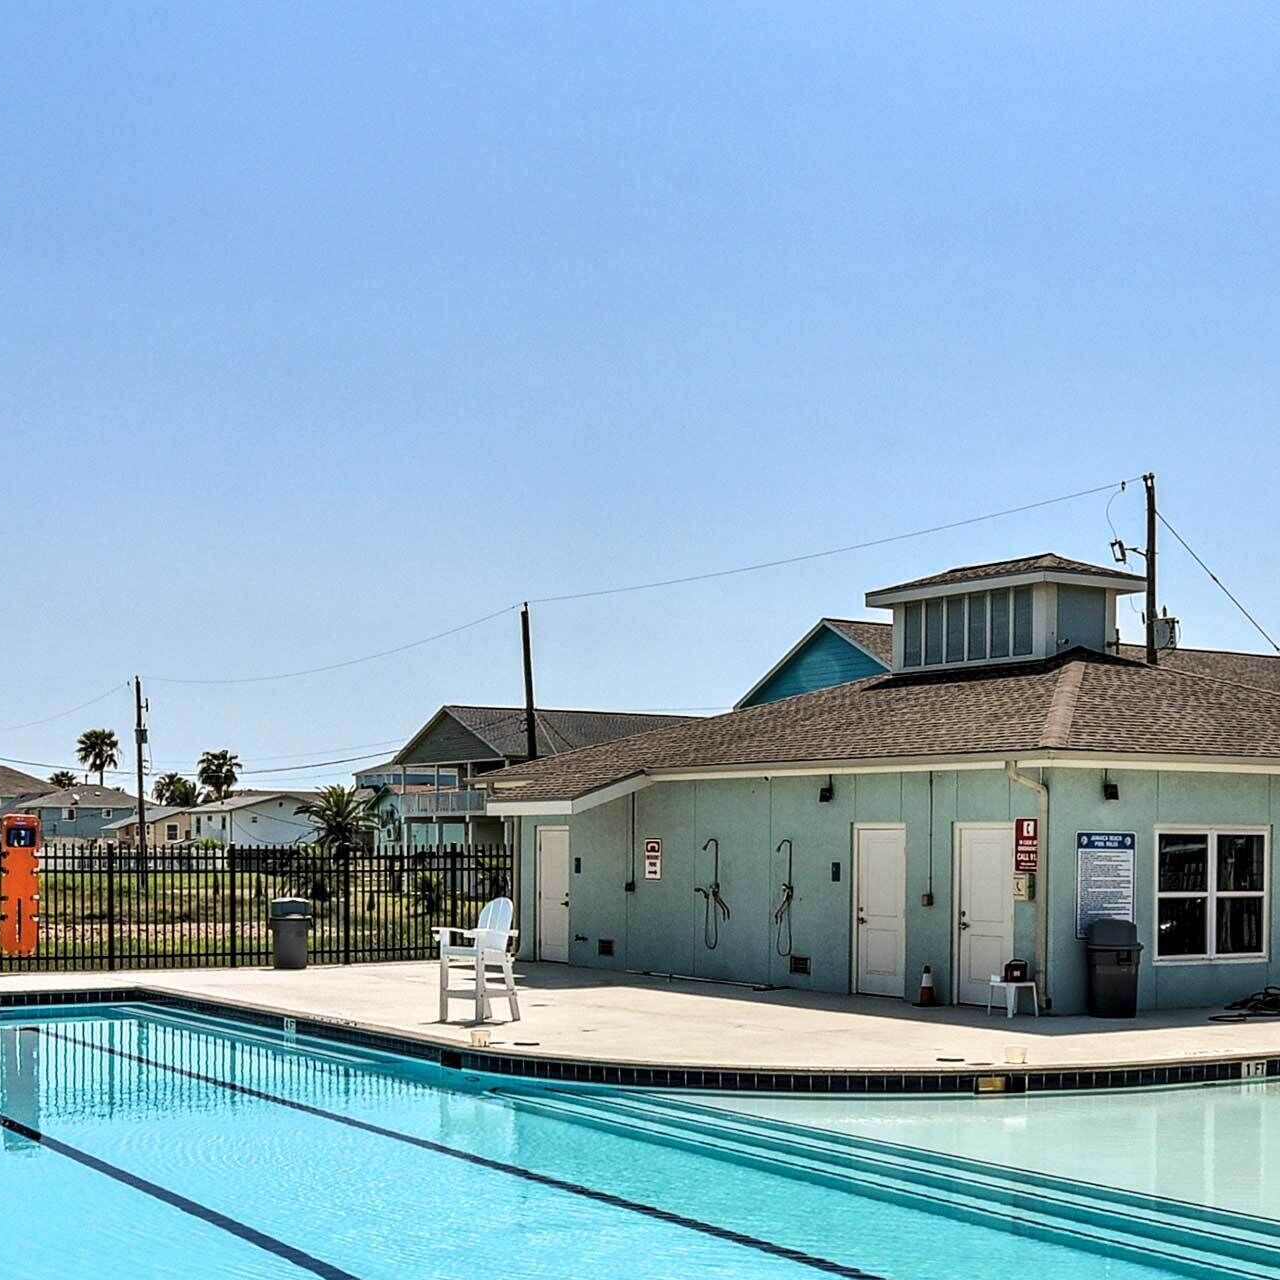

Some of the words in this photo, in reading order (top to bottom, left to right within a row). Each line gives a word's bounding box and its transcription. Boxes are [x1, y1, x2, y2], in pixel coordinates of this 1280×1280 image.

[1017, 853, 1029, 861] CALL
[1246, 1063, 1251, 1076] 1
[1255, 1062, 1266, 1076] FT
